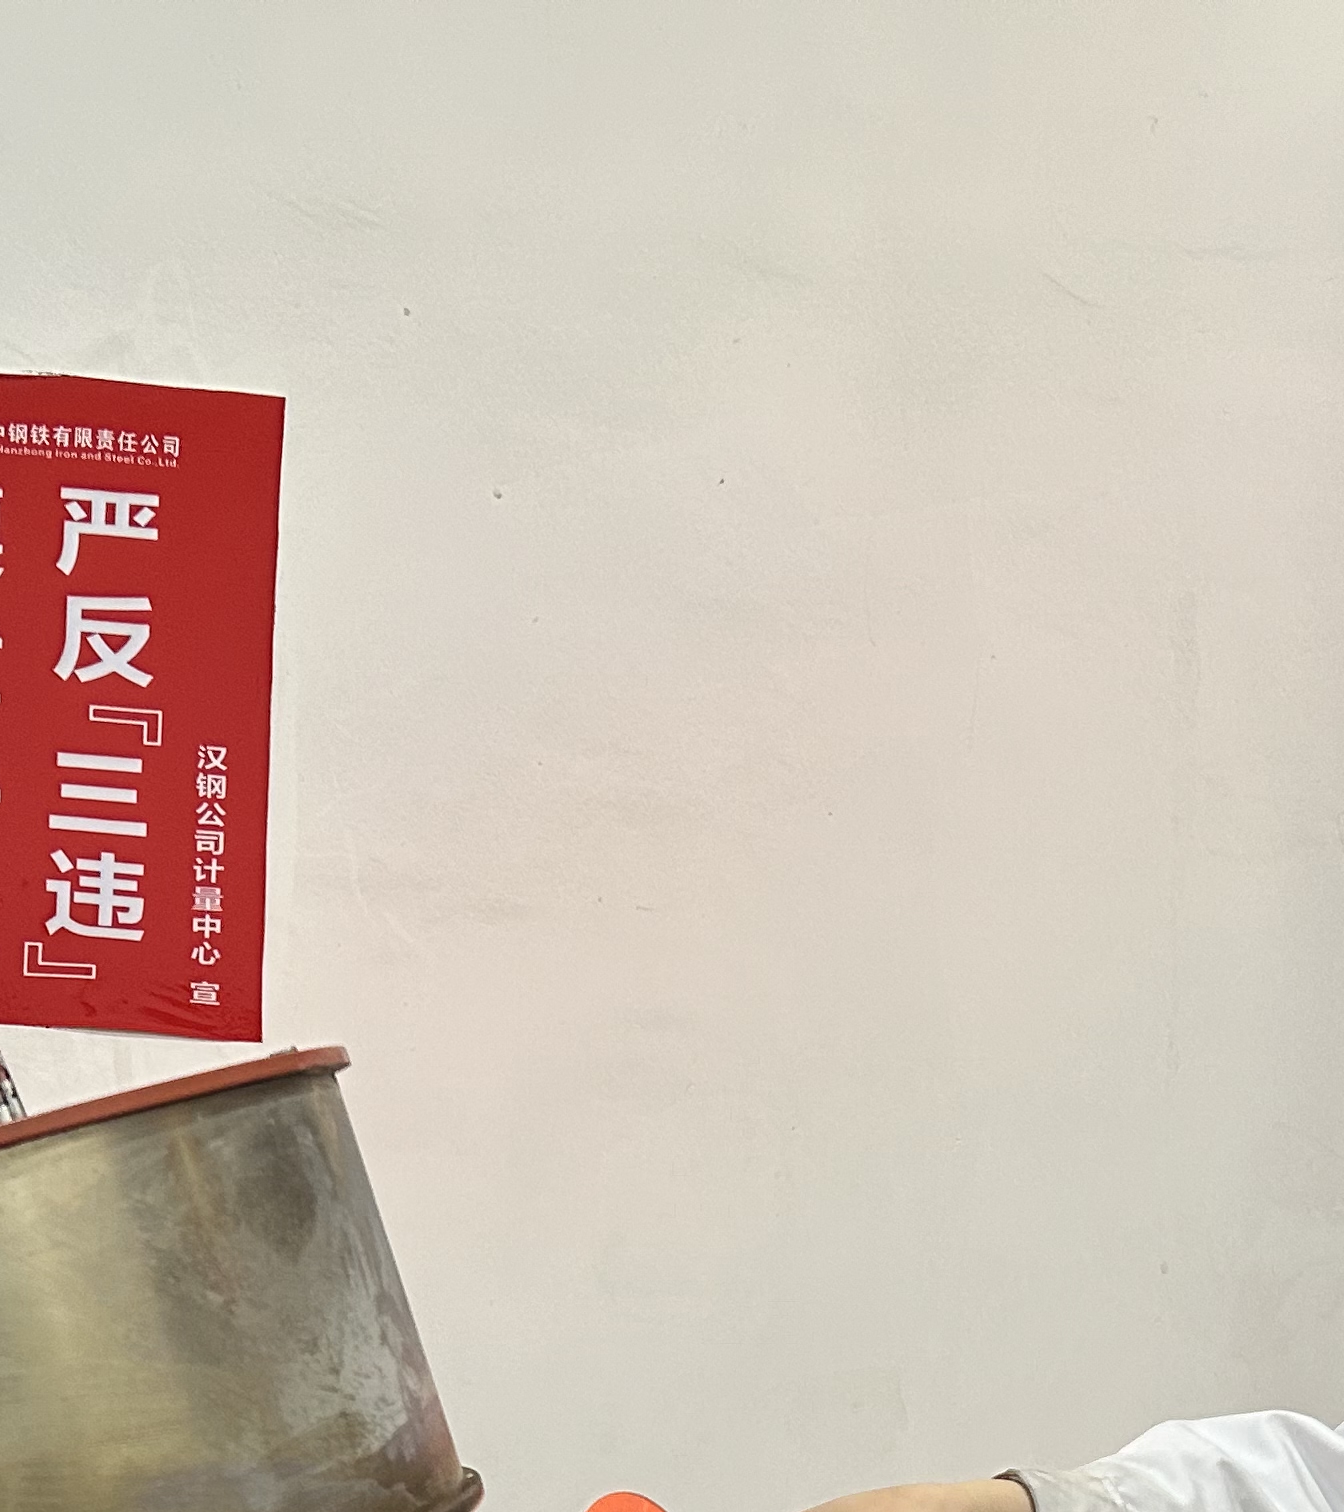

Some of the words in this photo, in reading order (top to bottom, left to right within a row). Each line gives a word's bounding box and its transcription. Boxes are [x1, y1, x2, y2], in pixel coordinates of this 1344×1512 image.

[55, 448, 78, 459] Iron
[81, 450, 102, 461] and
[104, 452, 135, 465] Steel
[190, 744, 228, 967] 汉钢公司计量中心
[189, 980, 221, 1007] 宣
